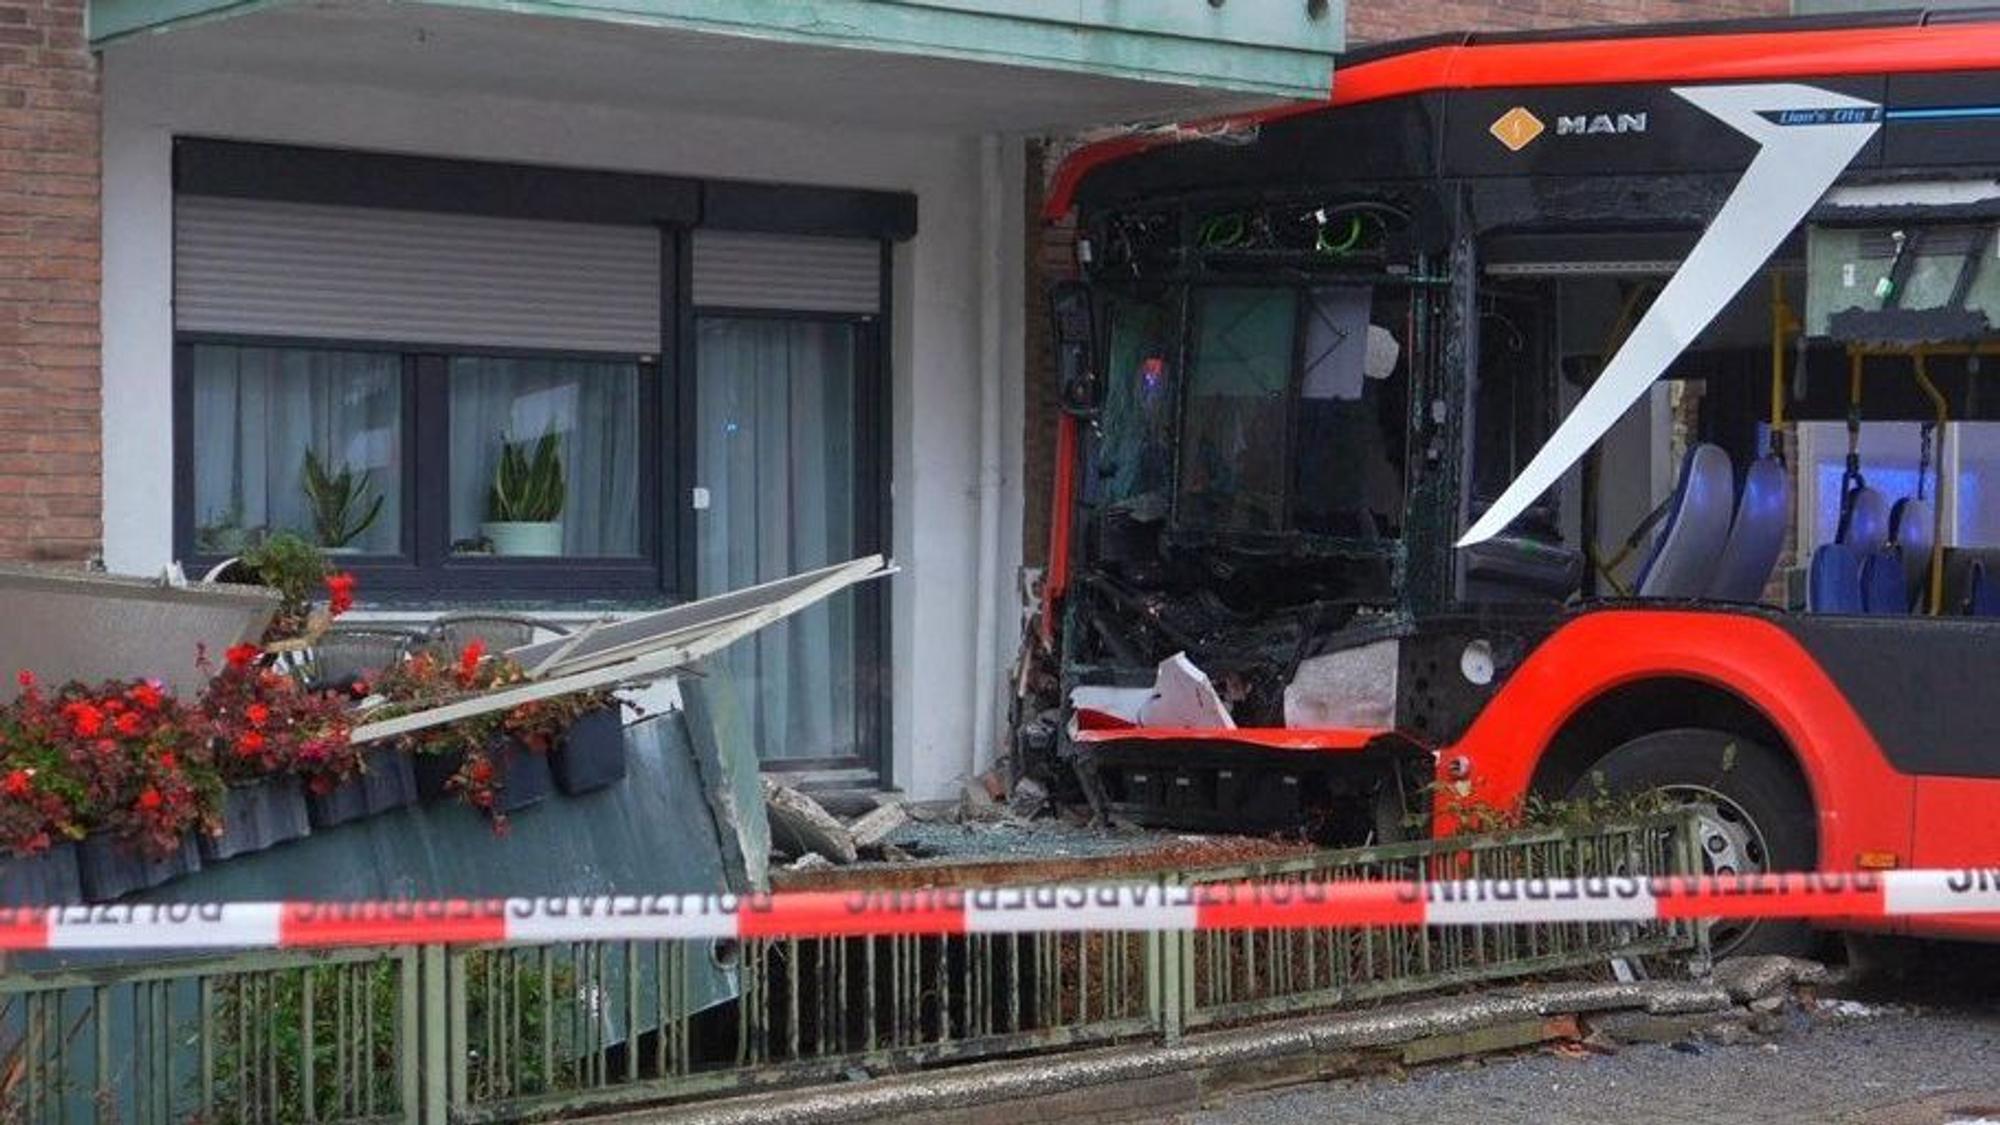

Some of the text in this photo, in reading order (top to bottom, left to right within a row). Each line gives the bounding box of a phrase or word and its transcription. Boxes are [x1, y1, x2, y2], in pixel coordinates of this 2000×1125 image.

[1556, 112, 1647, 135] MAN
[1780, 109, 1828, 124] Lion's
[1833, 107, 1866, 123] City
